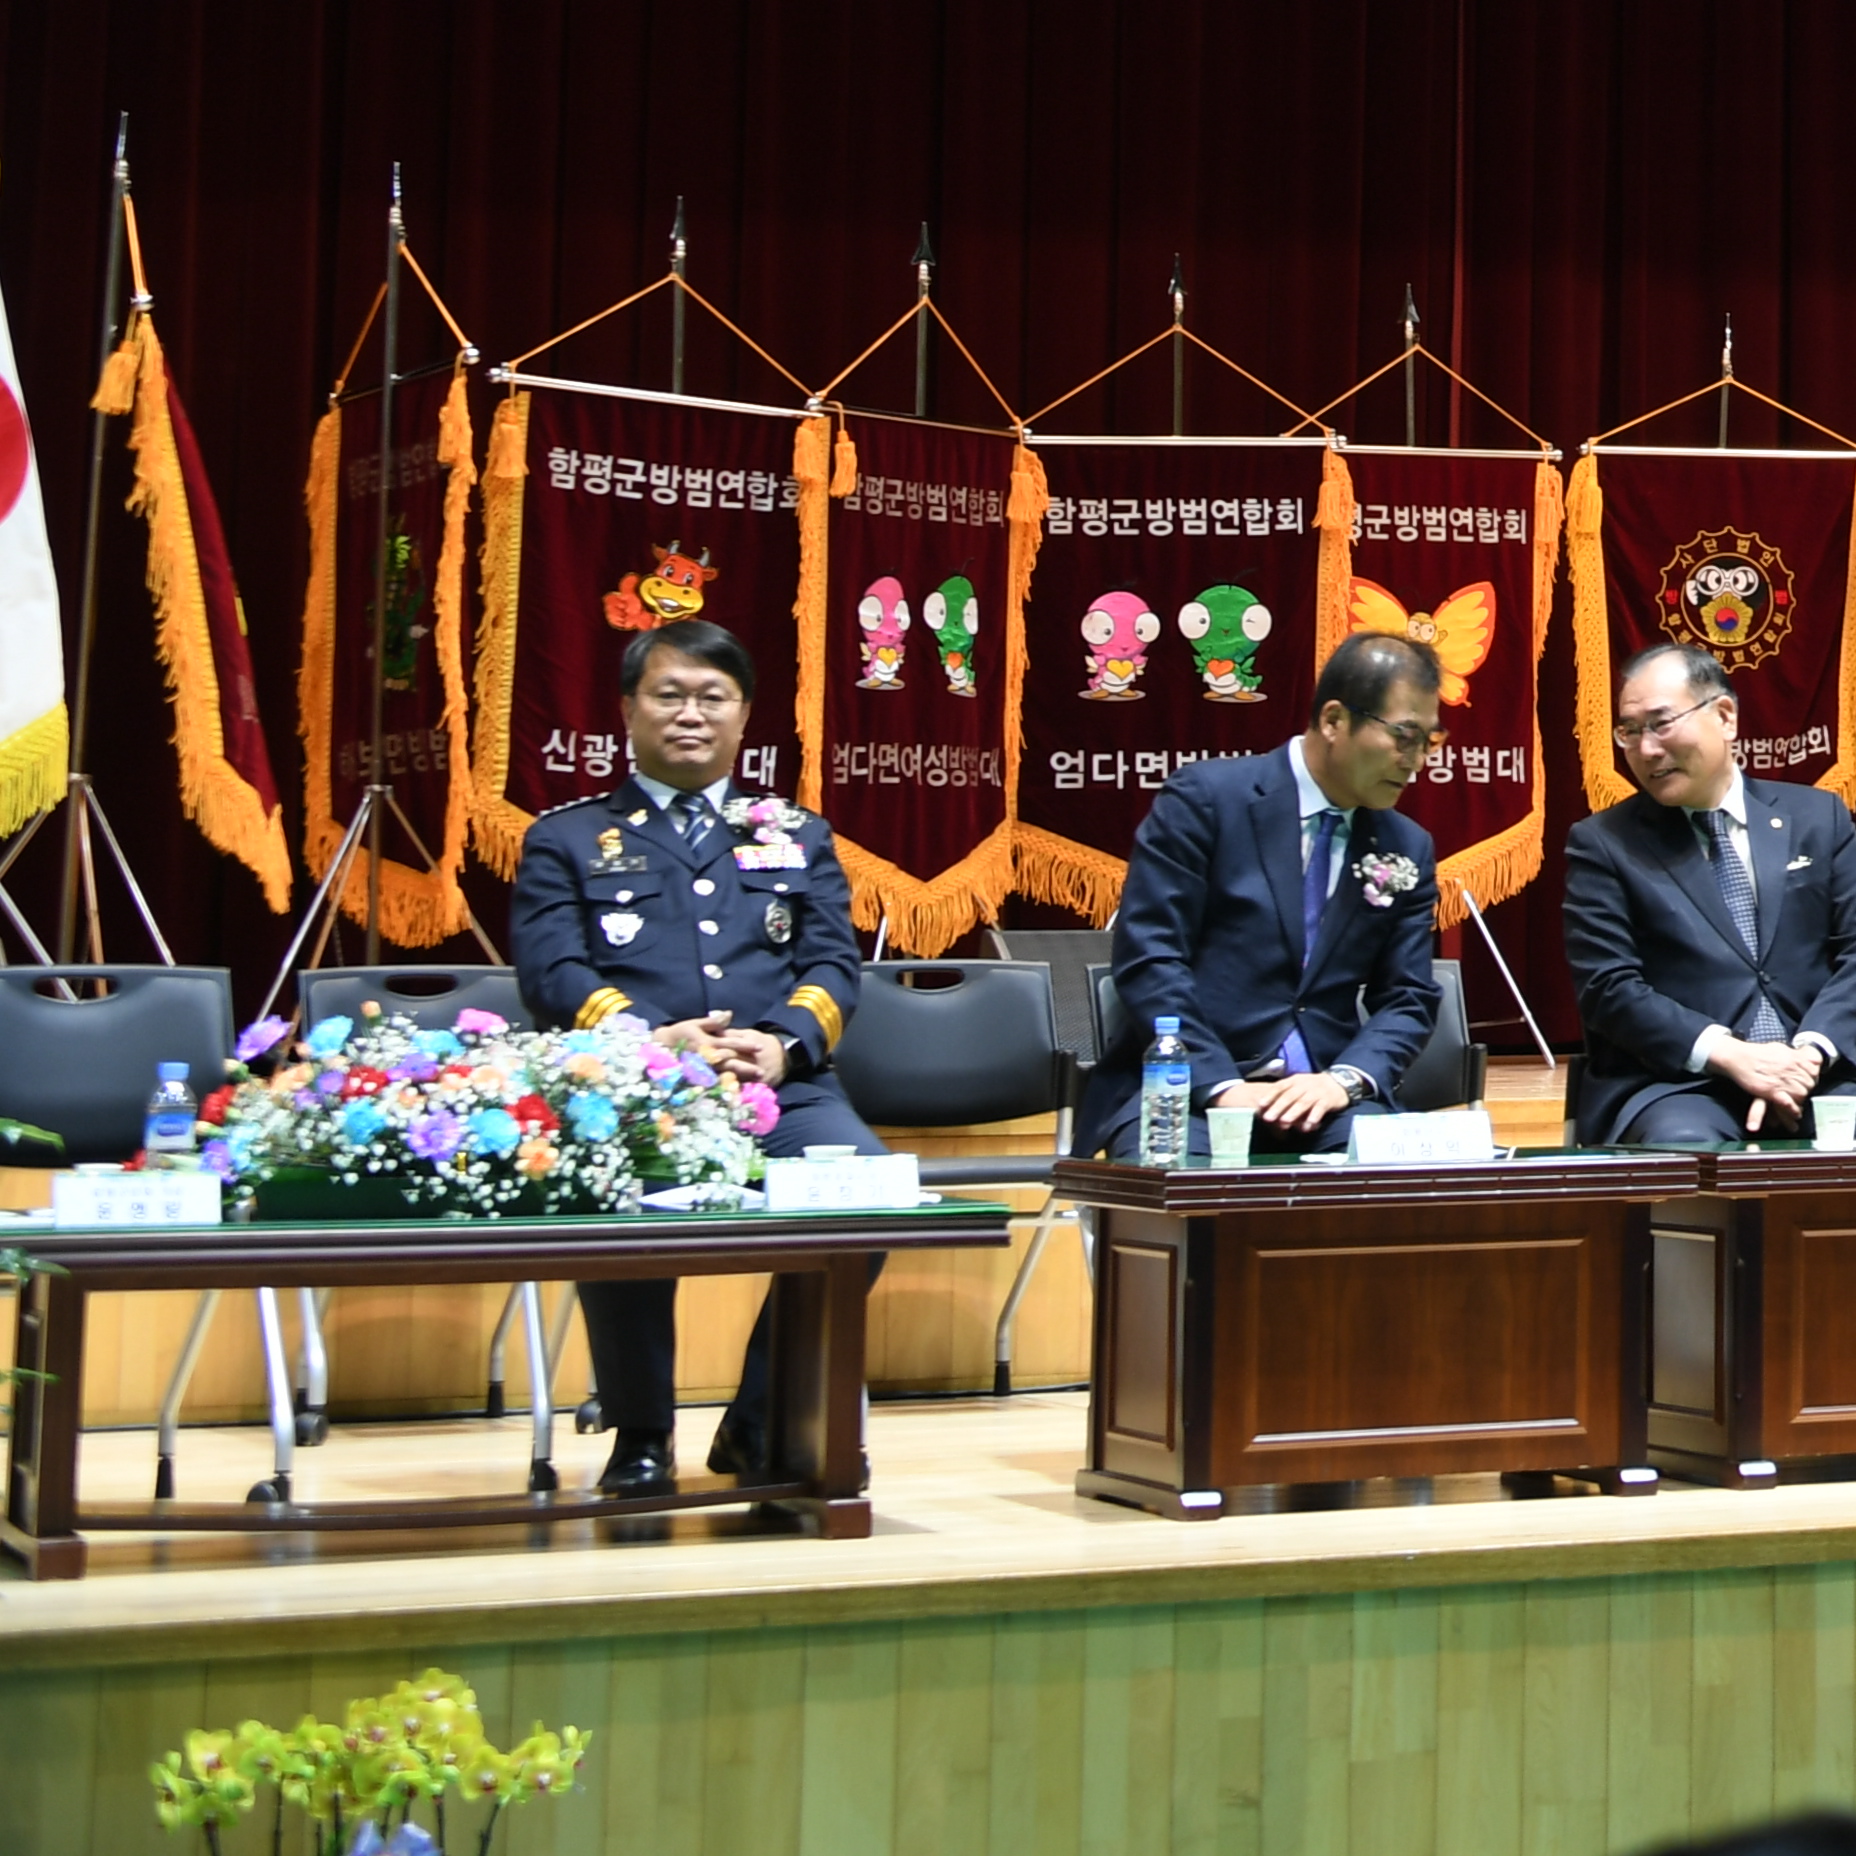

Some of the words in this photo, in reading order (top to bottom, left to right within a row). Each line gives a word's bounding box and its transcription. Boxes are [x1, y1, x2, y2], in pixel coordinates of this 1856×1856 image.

[1046, 497, 1305, 536] 함평군방범연합회
[831, 742, 1003, 788] 엄다면여성방범대
[1049, 749, 1267, 789] 엄다면
[1407, 744, 1526, 784] 방범대
